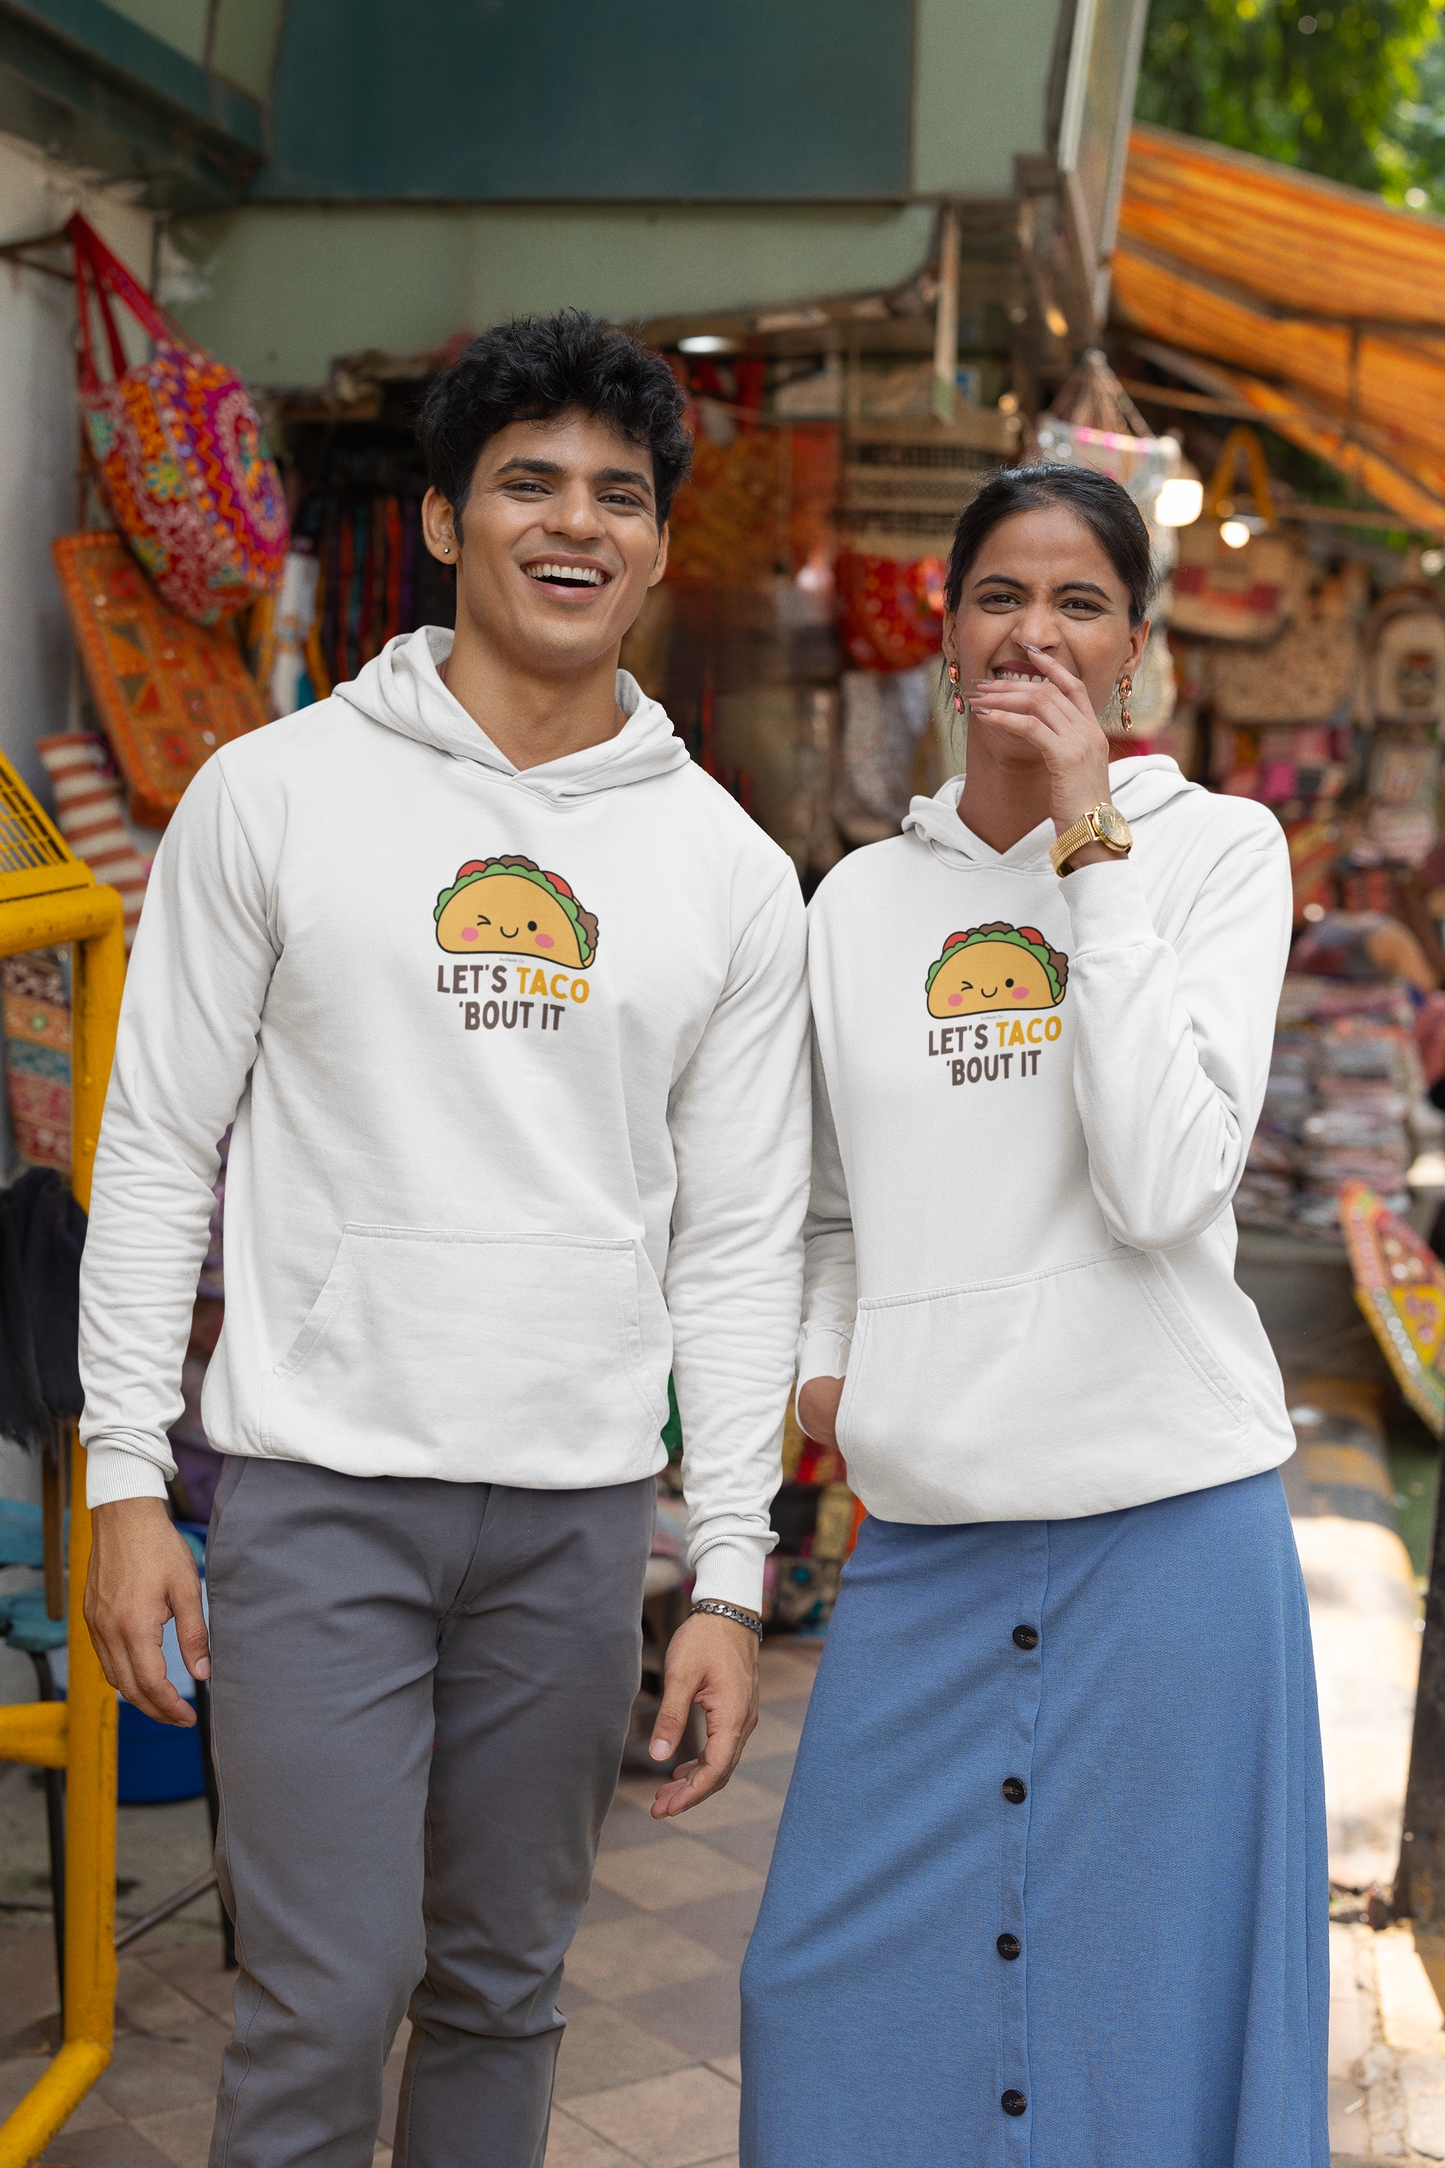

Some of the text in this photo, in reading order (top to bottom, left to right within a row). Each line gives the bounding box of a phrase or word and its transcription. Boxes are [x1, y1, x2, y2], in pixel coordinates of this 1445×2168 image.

[437, 964, 590, 1004] LET'S TACO
[459, 1000, 566, 1031] 'BOUT IT
[928, 1015, 1062, 1057] LET'S TACO
[946, 1049, 1042, 1087] 'BOUT IT
